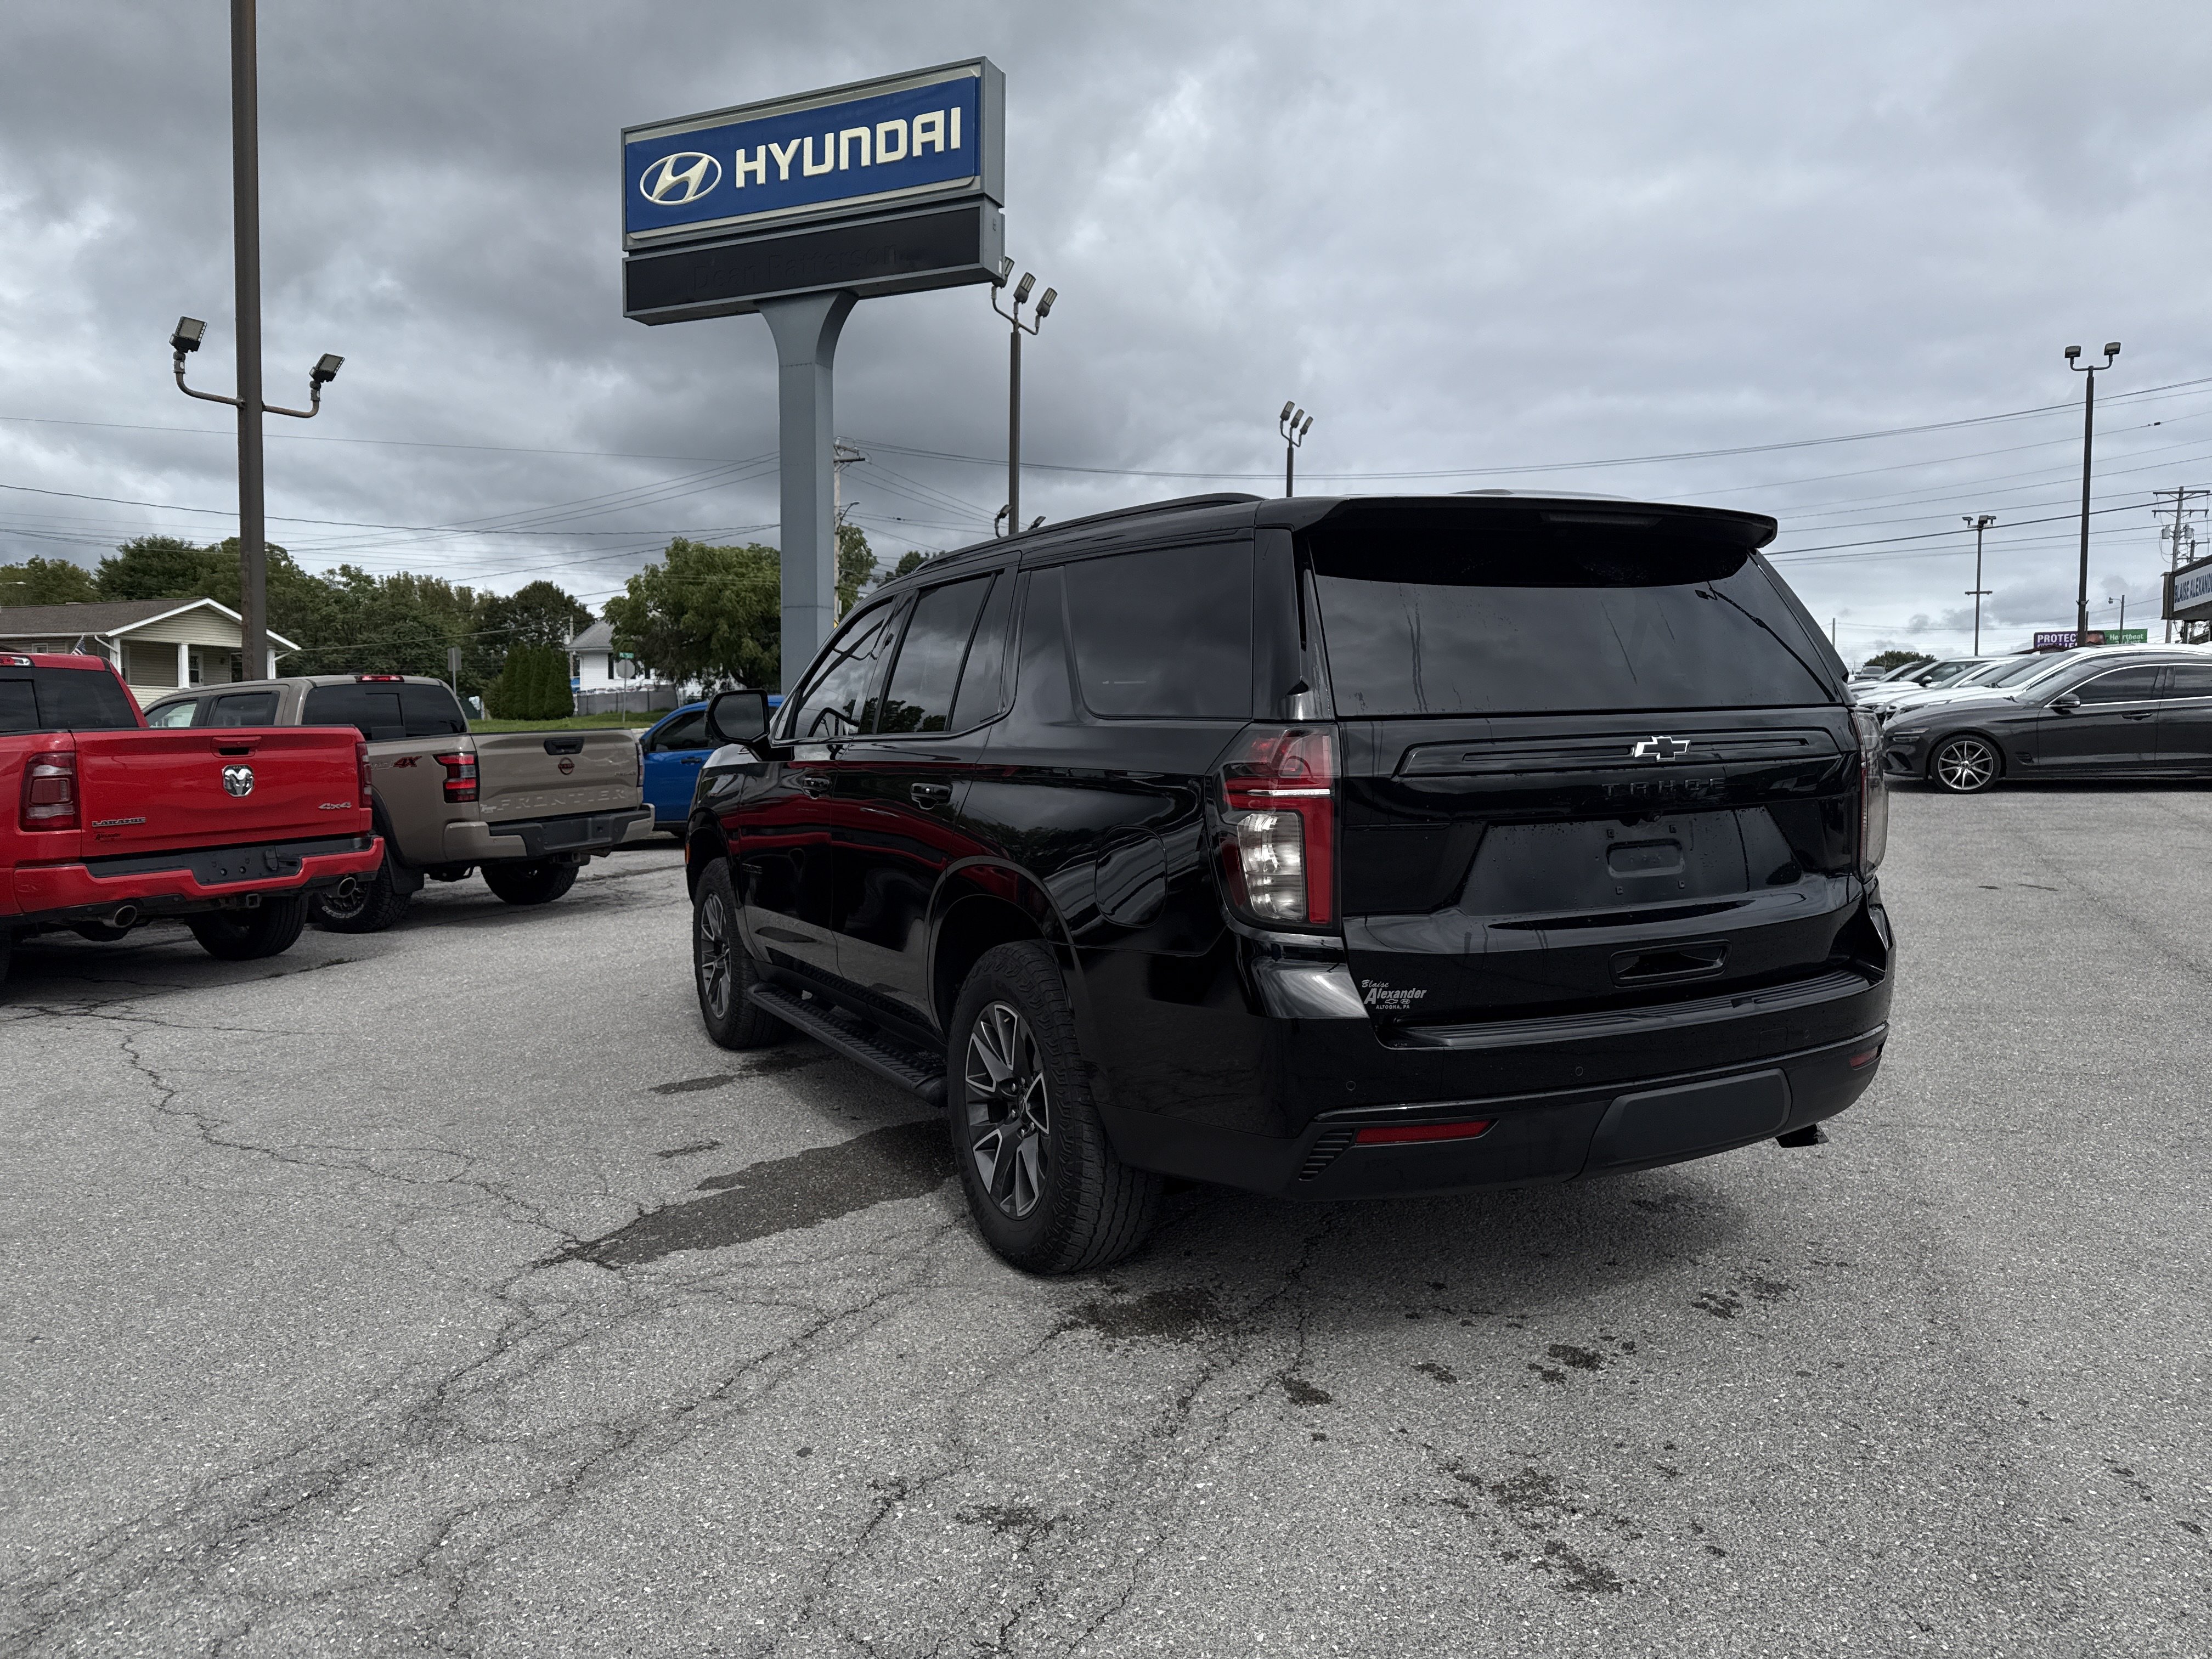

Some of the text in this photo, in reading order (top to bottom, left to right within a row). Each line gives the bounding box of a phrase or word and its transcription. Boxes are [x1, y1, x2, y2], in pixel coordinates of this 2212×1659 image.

[735, 106, 961, 189] HYUNDAI
[2174, 572, 2212, 603] BLAISE ALEXAND
[2037, 633, 2078, 643] PROTEC
[1601, 777, 1725, 797] TAHOE
[497, 788, 627, 811] FRONTIER
[1361, 979, 1390, 988] Blaise
[1363, 988, 1427, 1005] Alexander
